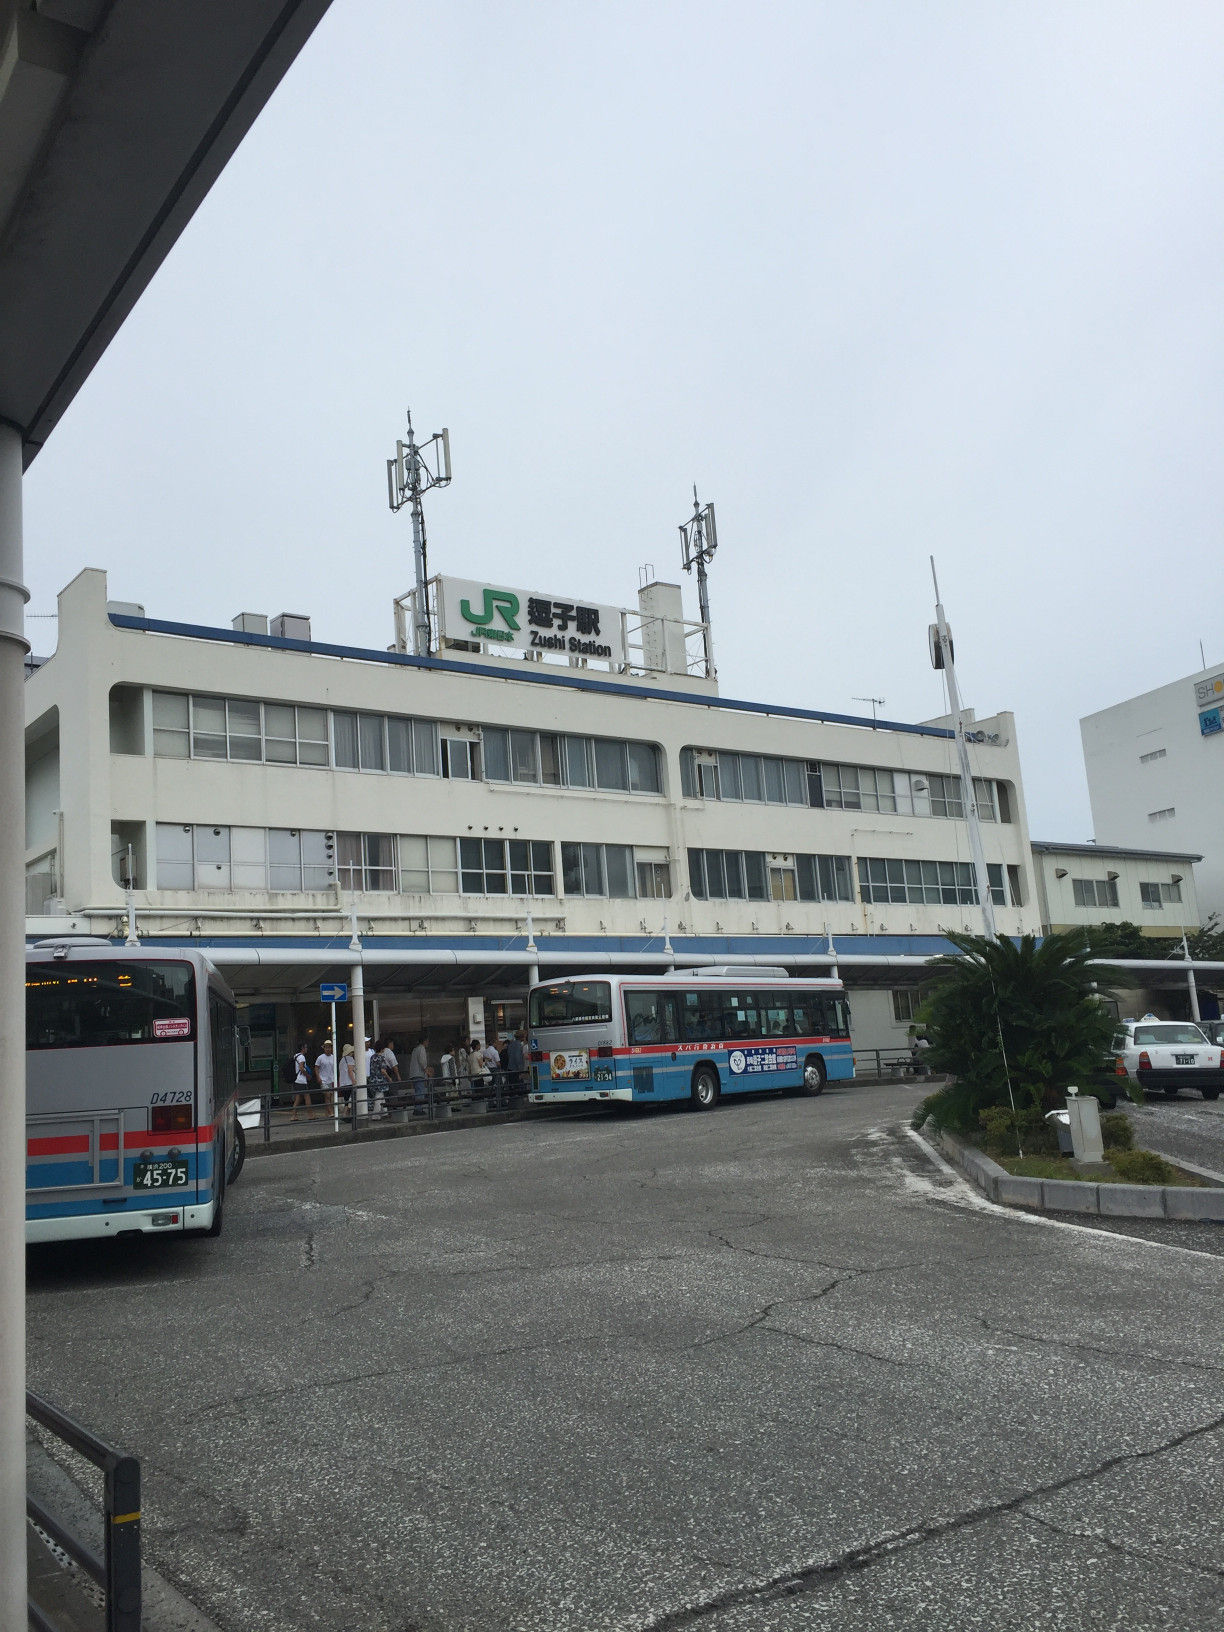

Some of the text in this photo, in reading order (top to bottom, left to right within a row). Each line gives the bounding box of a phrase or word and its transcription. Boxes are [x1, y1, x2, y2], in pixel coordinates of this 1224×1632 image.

[460, 588, 521, 630] JR
[530, 630, 612, 657] Zushi Station
[150, 1090, 192, 1105] D4728
[143, 1168, 187, 1187] 45-75
